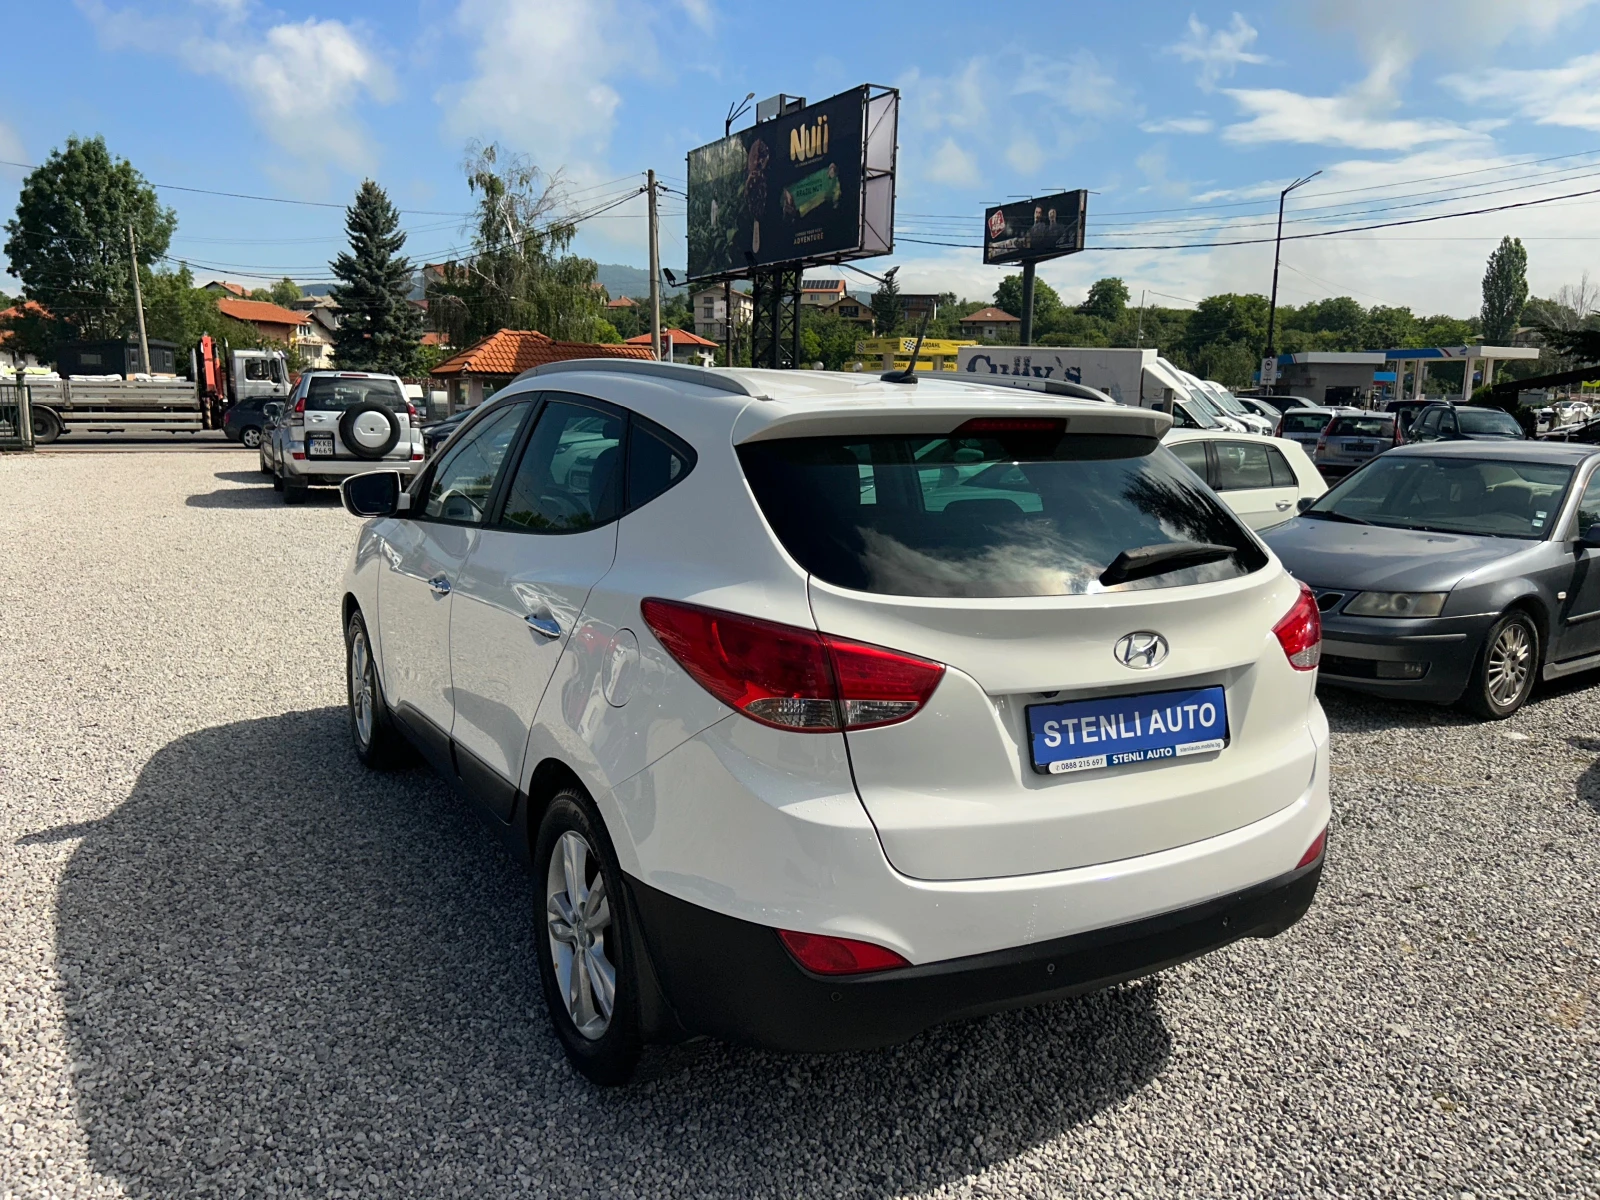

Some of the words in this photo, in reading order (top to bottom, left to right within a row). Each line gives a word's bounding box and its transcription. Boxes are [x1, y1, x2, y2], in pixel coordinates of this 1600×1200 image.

[793, 232, 824, 245] ADVENTURE
[920, 342, 941, 350] ARDAHL
[1043, 711, 1142, 748] STENLI
[1148, 702, 1216, 735] AUTO
[1179, 742, 1221, 753] stenliauto.mobile.bg
[1112, 751, 1144, 764] STENLI
[1146, 747, 1173, 759] AUTO
[1061, 761, 1077, 771] 0888
[1078, 759, 1091, 768] 215
[1092, 757, 1104, 766] 697
